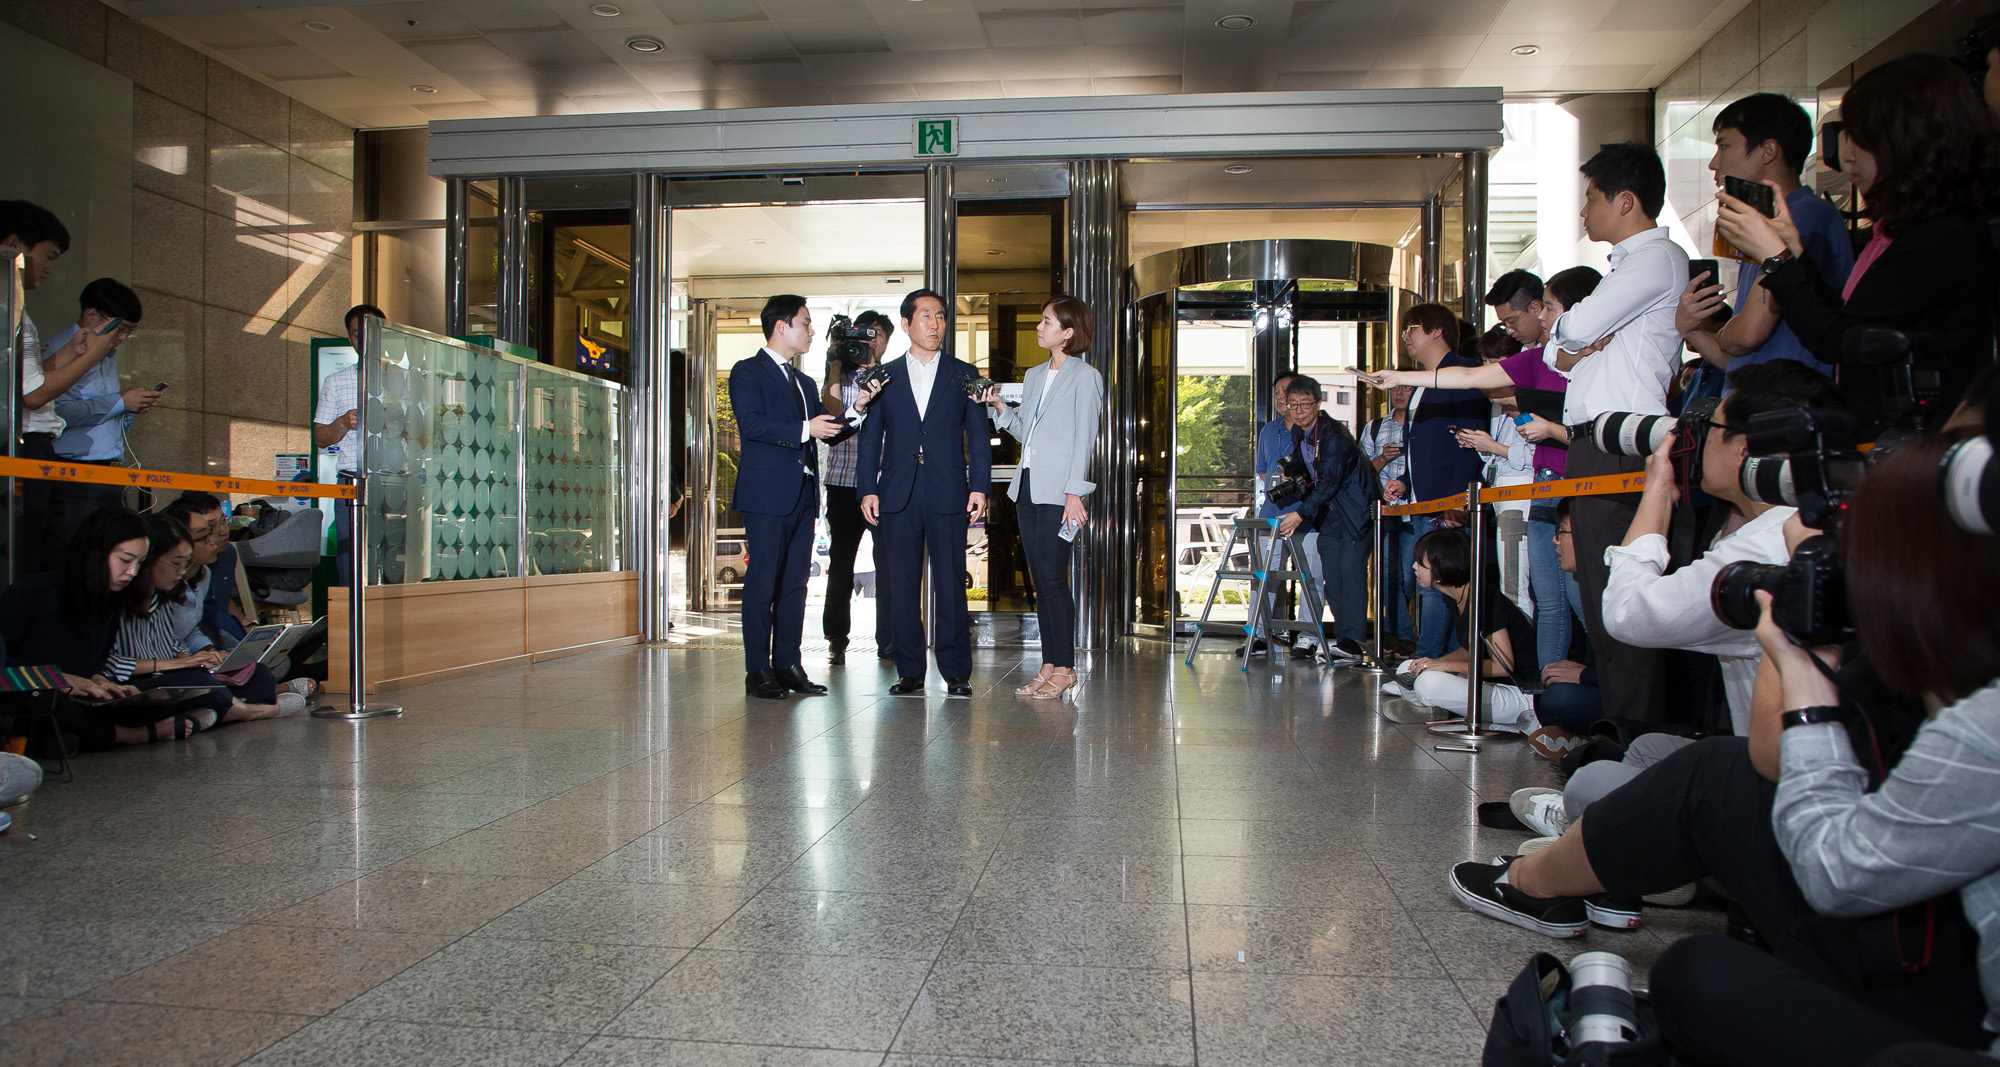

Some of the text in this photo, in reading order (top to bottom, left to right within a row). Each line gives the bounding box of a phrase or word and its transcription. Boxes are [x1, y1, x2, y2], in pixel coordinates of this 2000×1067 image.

[146, 474, 171, 484] POLICE
[290, 485, 309, 493] POLICE
[1538, 485, 1552, 493] POLICE
